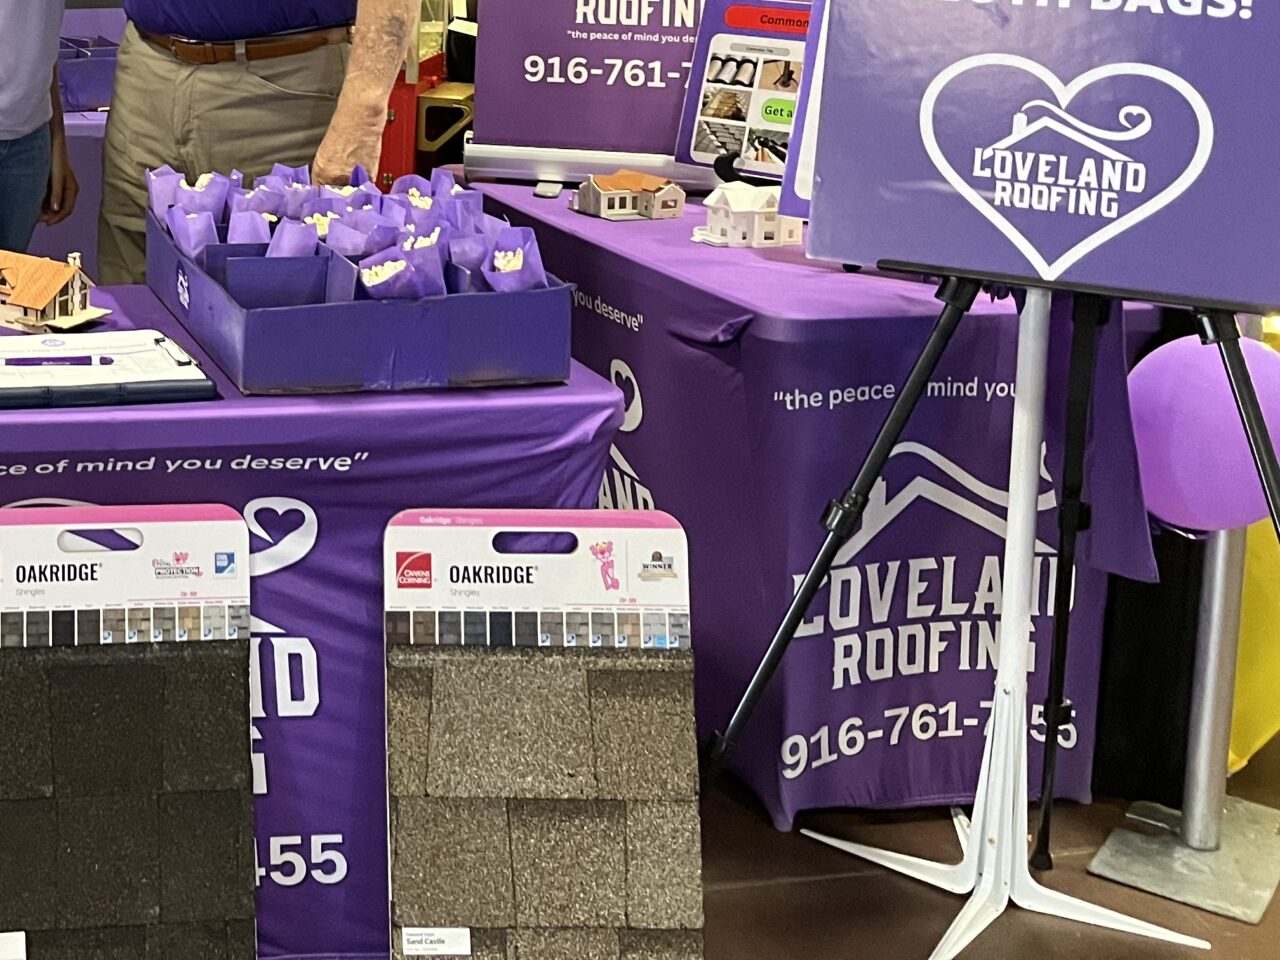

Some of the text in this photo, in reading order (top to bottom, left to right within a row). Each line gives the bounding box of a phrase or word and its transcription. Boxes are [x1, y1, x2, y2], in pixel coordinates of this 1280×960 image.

[589, 31, 620, 43] peace
[621, 30, 633, 43] of
[633, 31, 660, 43] mind
[661, 33, 681, 45] you
[764, 104, 785, 118] Get
[971, 146, 1148, 194] LOVELAND
[993, 179, 1119, 219] ROOFING
[926, 377, 978, 398] mind
[828, 382, 896, 410] peace
[34, 458, 70, 474] of
[76, 456, 156, 473] mind
[165, 458, 223, 474] you
[642, 562, 673, 570] WINNER
[403, 569, 431, 578] OWENS
[398, 577, 431, 585] CORNING
[15, 588, 46, 597] Shingles
[449, 588, 481, 597] Shingles
